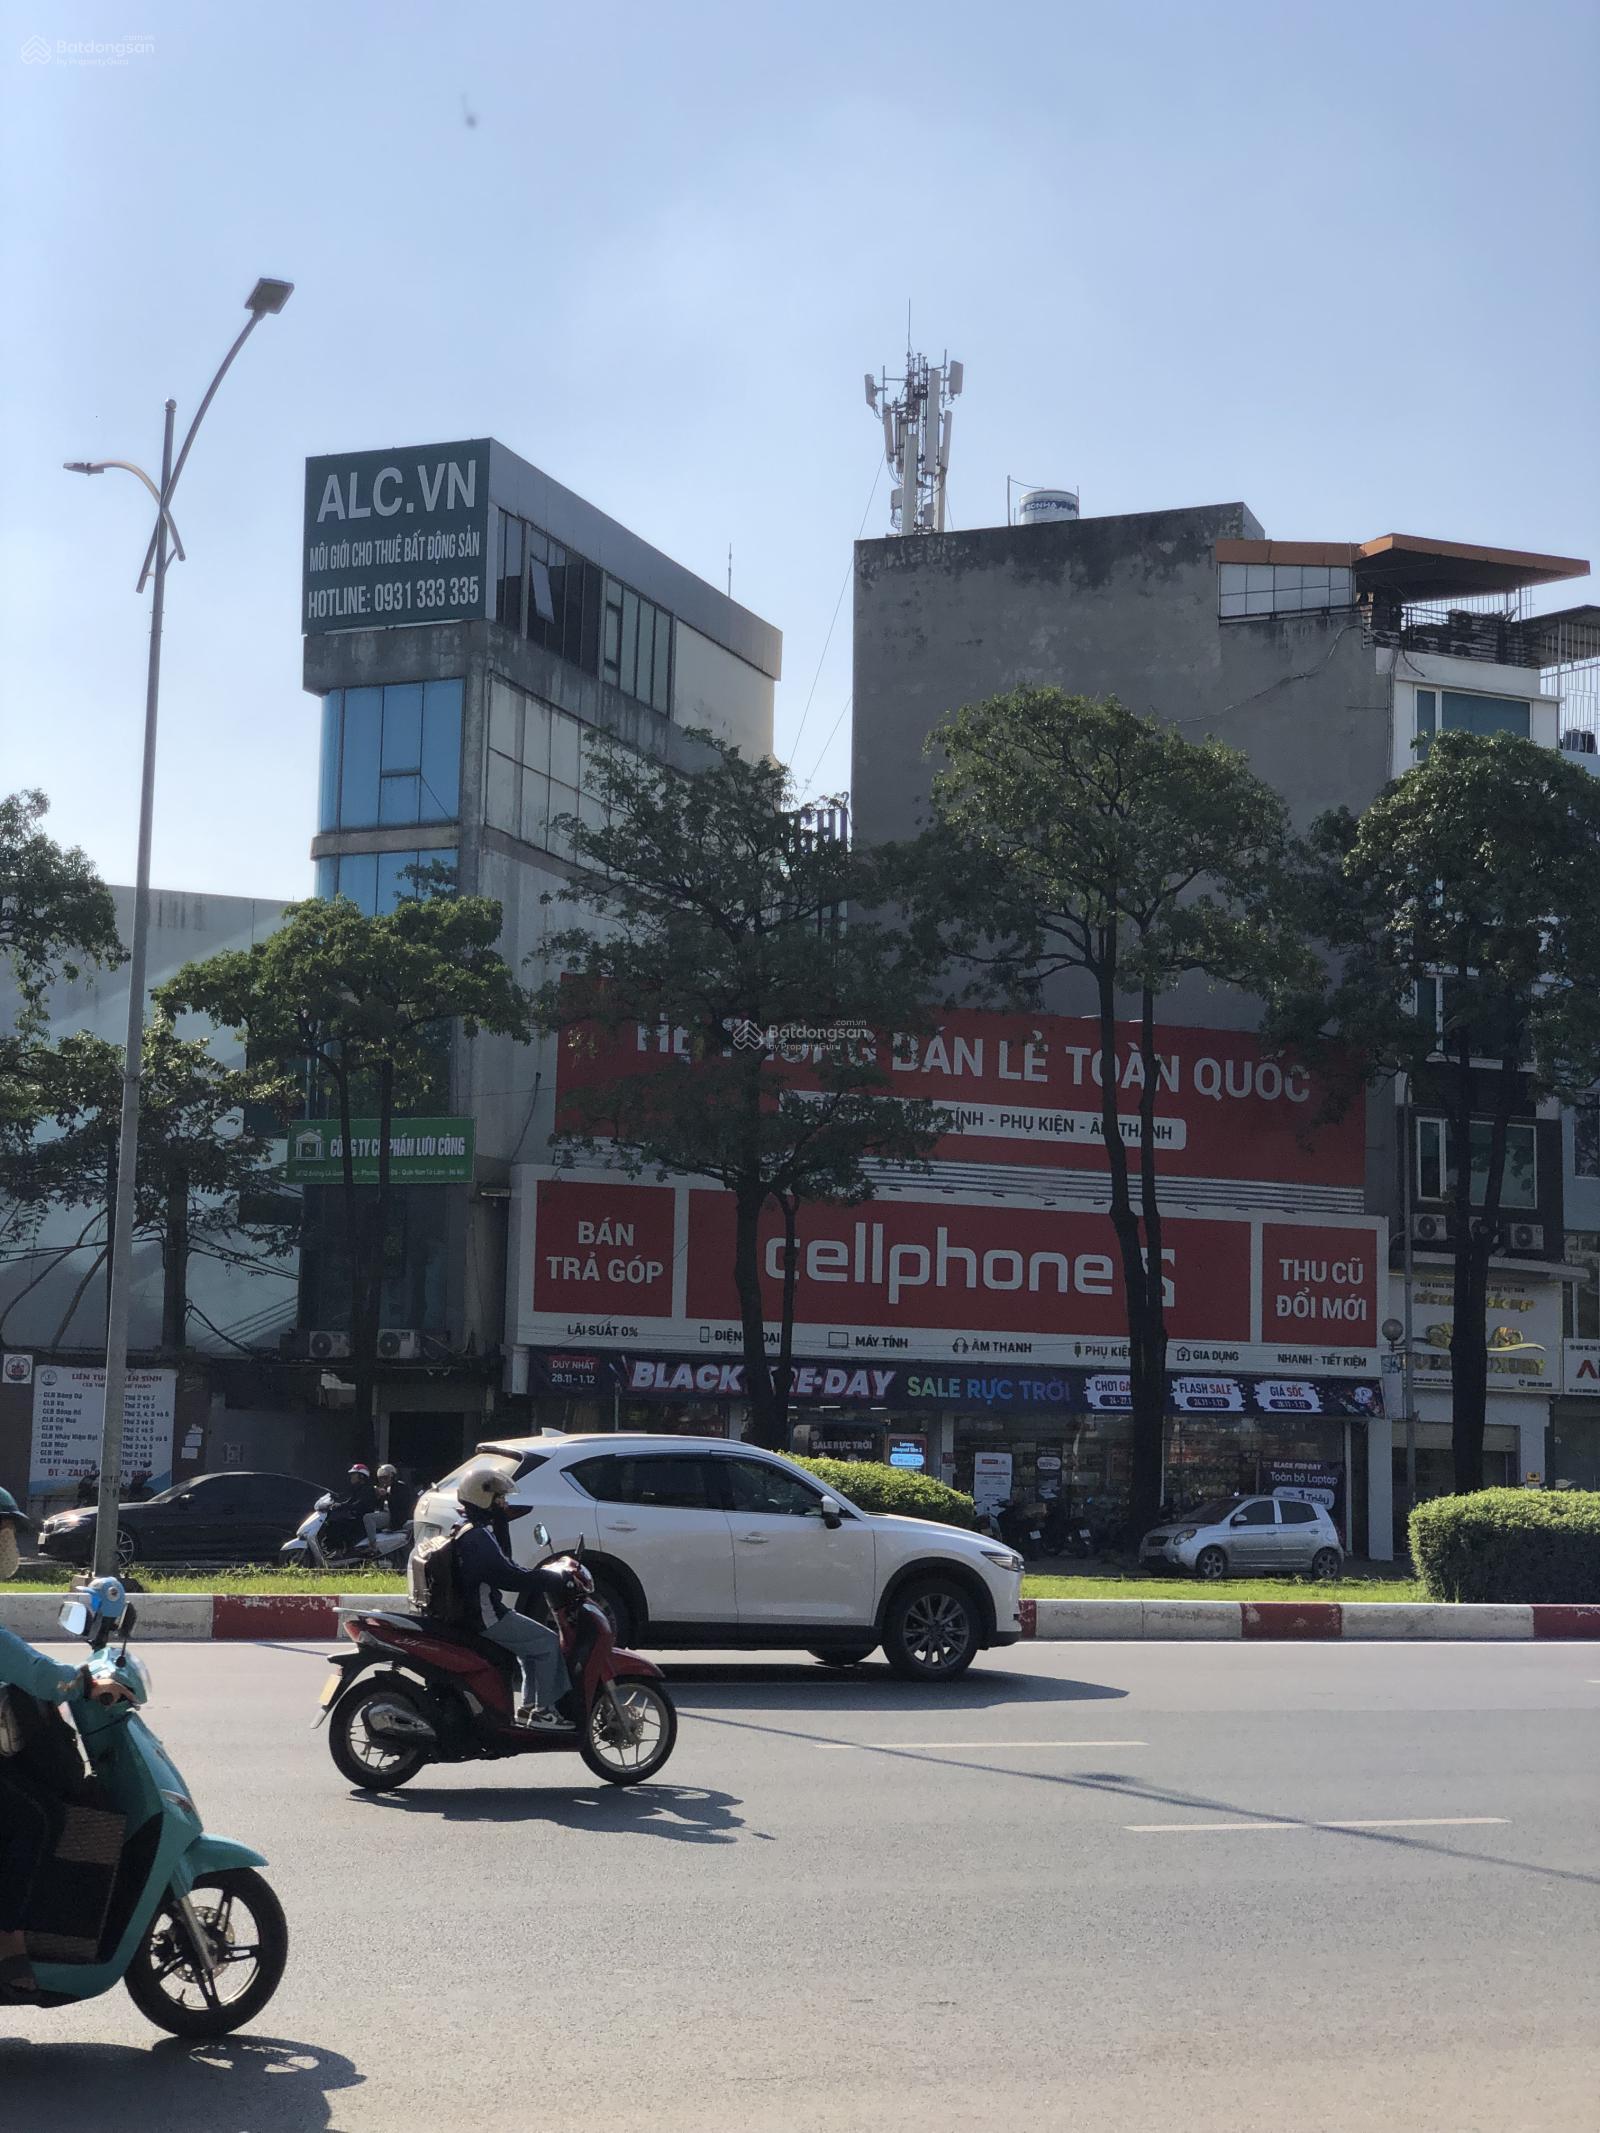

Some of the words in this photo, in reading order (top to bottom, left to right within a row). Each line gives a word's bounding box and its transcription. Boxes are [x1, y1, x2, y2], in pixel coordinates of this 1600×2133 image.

[317, 459, 477, 522] ALC.VN
[309, 543, 328, 571] MÔI
[330, 539, 350, 570] GIỚI
[352, 541, 373, 567] CHO
[375, 534, 401, 565] THUÊ
[404, 529, 426, 562] BẤT
[428, 531, 456, 565] ĐỘNG
[458, 524, 480, 558] SẢN
[308, 586, 371, 618] HOTLINE:
[375, 581, 411, 611] 0931
[417, 579, 446, 608] 333
[450, 576, 478, 605] 335
[892, 1026, 983, 1077] BÁN
[999, 1029, 1049, 1083] LẺ
[1065, 1043, 1180, 1093] TOÀN
[1194, 1049, 1310, 1103] QUỐC
[1000, 1113, 1032, 1134] PHỤ
[1037, 1115, 1074, 1136] KIỆN
[1119, 1123, 1172, 1140] THNH
[359, 1139, 371, 1157] TY
[578, 1217, 634, 1246] BÁN
[546, 1251, 601, 1281] TRẢ
[607, 1254, 664, 1284] GÓP
[1279, 1258, 1327, 1282] THU
[1331, 1256, 1364, 1285] CŨ
[1276, 1286, 1316, 1318] ĐỔI
[1322, 1293, 1367, 1321] MỚI
[567, 1322, 587, 1336] LÃI
[588, 1321, 619, 1337] SUẤT
[621, 1326, 639, 1337] 0%
[714, 1328, 742, 1345] ĐIỆN
[855, 1335, 878, 1348] MÁY
[882, 1336, 909, 1349] TÍNH
[971, 1338, 990, 1353] ÂM
[994, 1341, 1032, 1353] THANH
[1085, 1345, 1108, 1359] PHỤ
[1111, 1346, 1132, 1360] KIỆ
[1193, 1350, 1209, 1361] GIA
[1212, 1351, 1240, 1364] DỤNG
[552, 1360, 570, 1369] DUY
[1277, 1353, 1313, 1365] NHANH
[1322, 1354, 1343, 1367] TIẾT
[1344, 1356, 1368, 1370] KIỆM
[631, 1361, 744, 1391] BLACK
[907, 1376, 961, 1398] SALE
[965, 1376, 1014, 1405] RỰC
[1018, 1376, 1071, 1401] TRỜI
[1180, 1382, 1208, 1394] FLASH
[1210, 1383, 1233, 1395] SALE
[1270, 1384, 1285, 1397] GIÁ
[1286, 1382, 1305, 1398] SỐC
[1271, 1471, 1293, 1482] Toàn
[1307, 1474, 1340, 1486] Laptop
